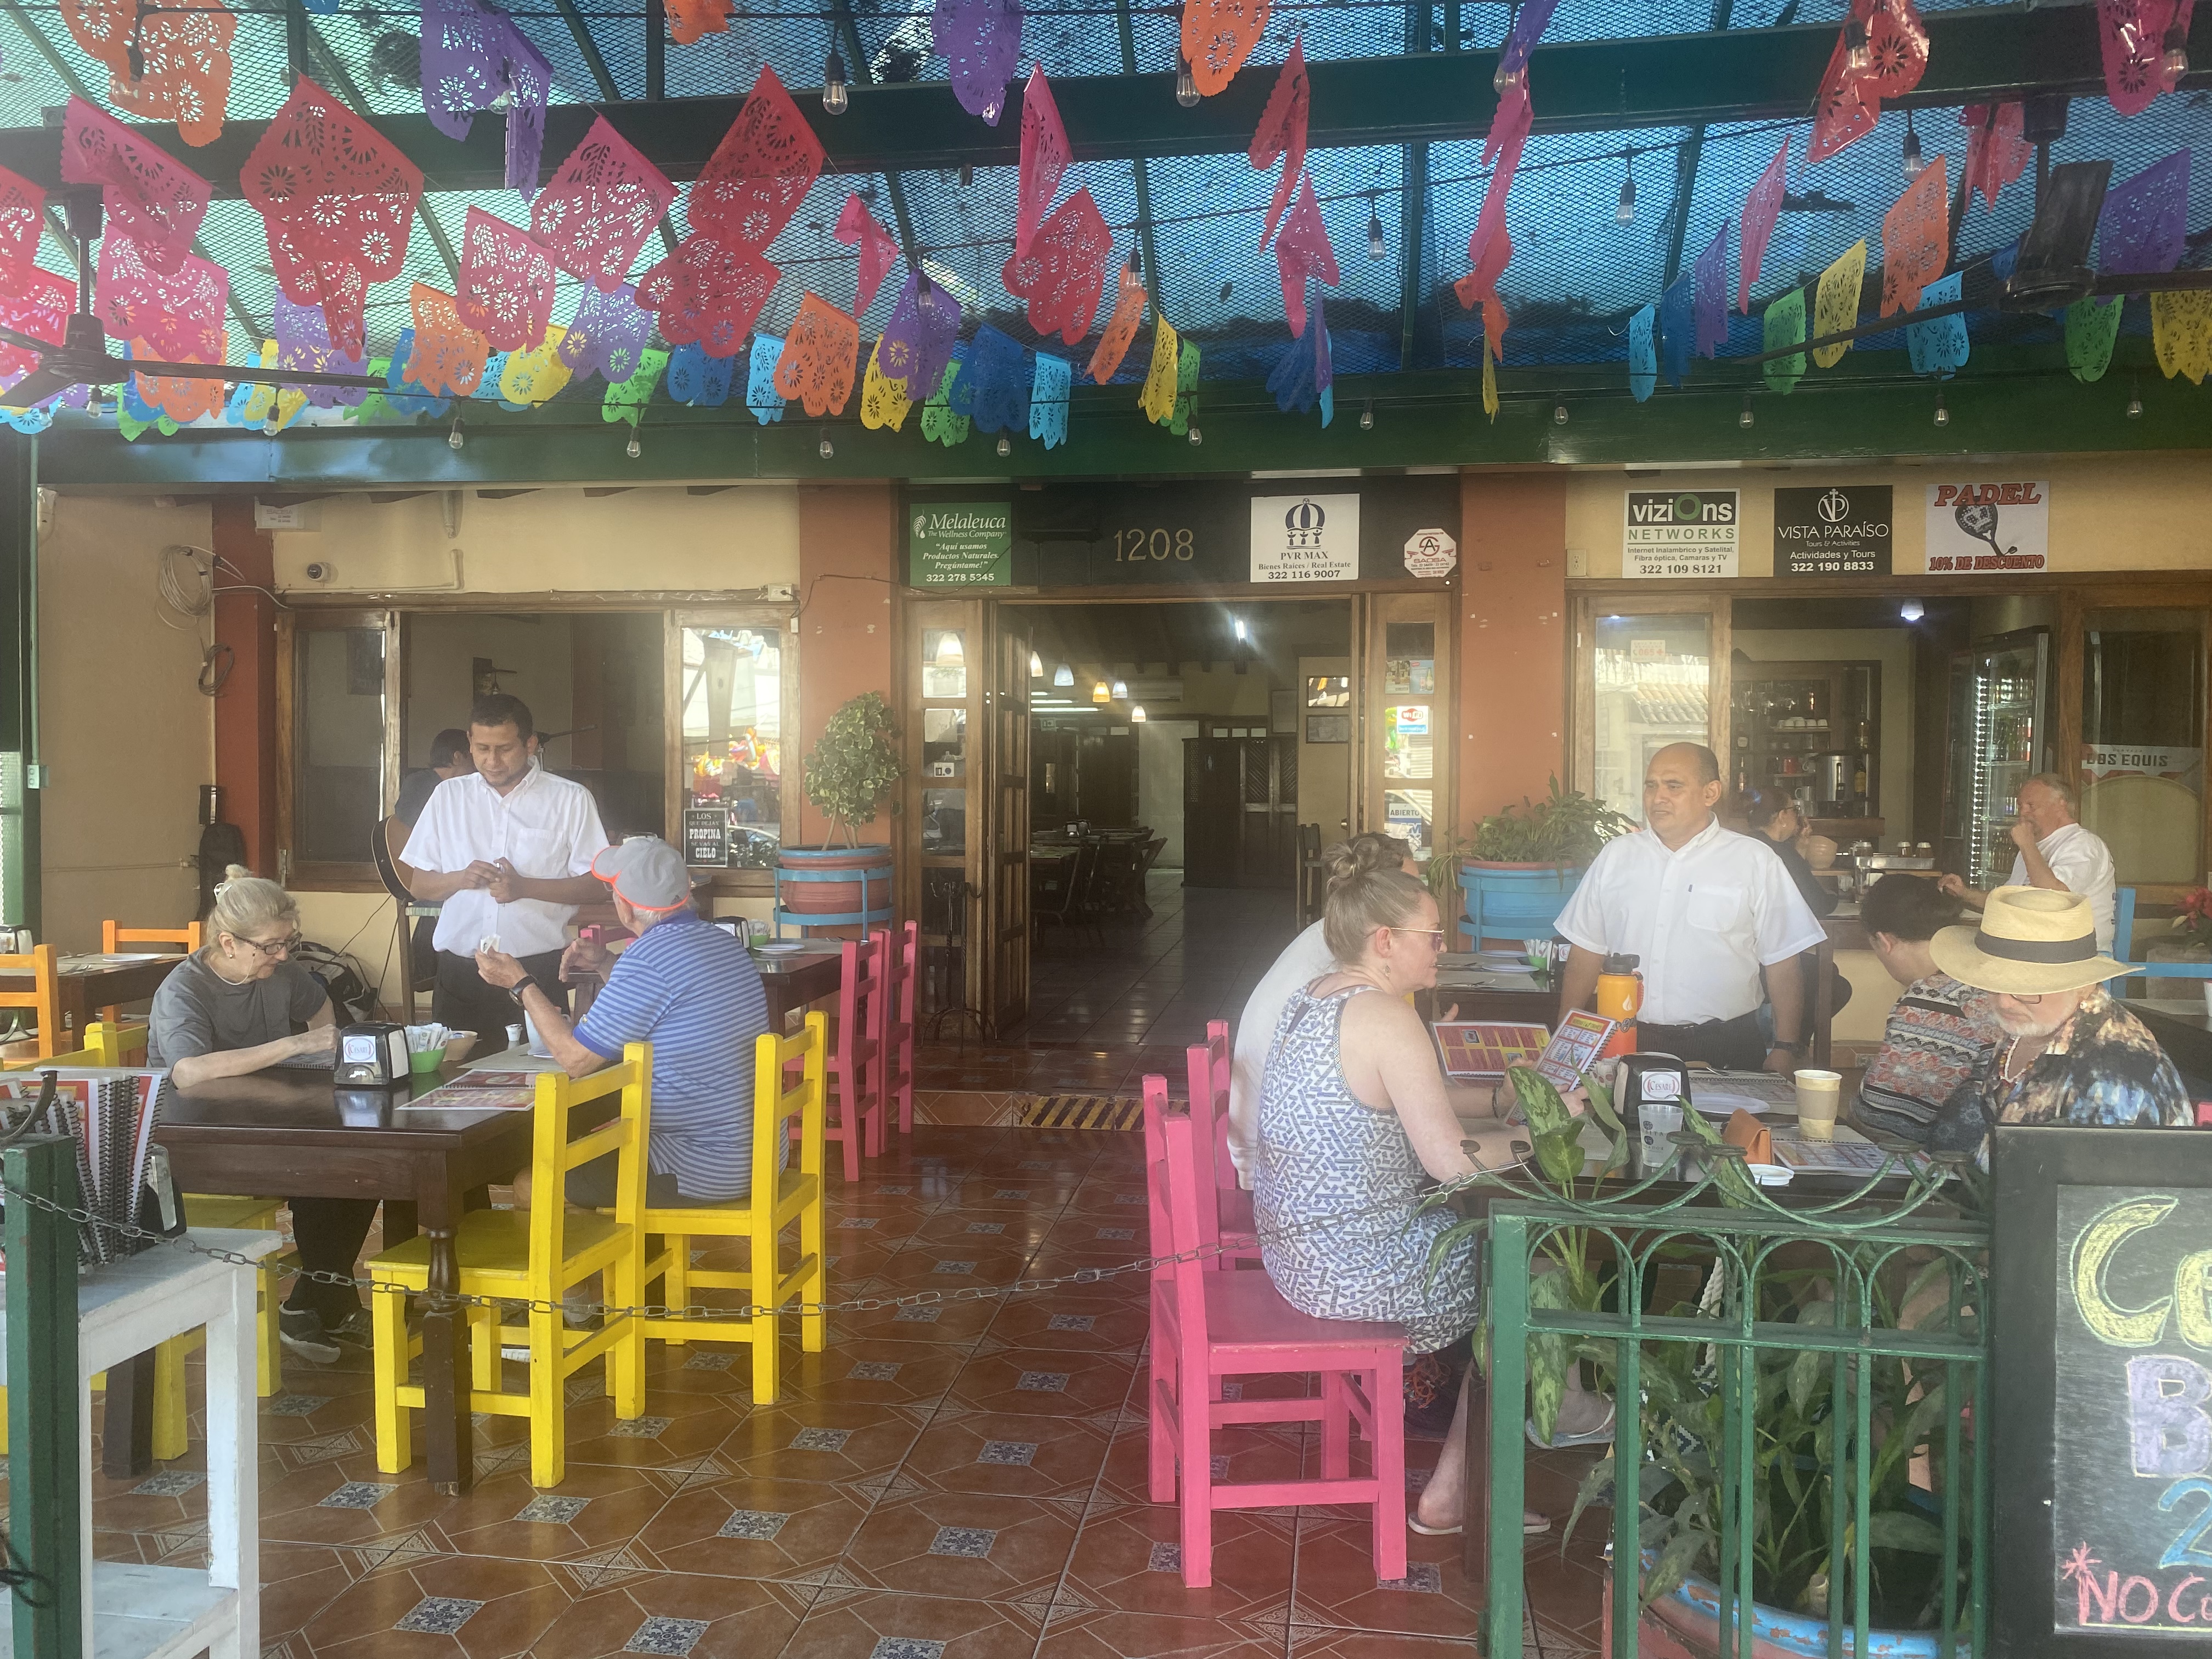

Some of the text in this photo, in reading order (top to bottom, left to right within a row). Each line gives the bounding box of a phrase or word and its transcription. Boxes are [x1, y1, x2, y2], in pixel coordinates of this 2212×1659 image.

[1934, 483, 2041, 506] PADEL
[928, 513, 1006, 529] Melaleuca
[1628, 528, 1734, 540] NETWORKS
[1778, 521, 1888, 539] VISTA PARAÍSO
[1114, 528, 1194, 561] 1208
[1280, 551, 1329, 560] PVR MAX
[1790, 551, 1841, 559] Actividades
[1791, 561, 1874, 572] 322 190 8833
[1929, 554, 2045, 571] 10% DE DESCUENTO
[1640, 565, 1722, 574] 322 109 8121
[2121, 754, 2168, 766] EQUIS
[690, 828, 721, 839] PROPINA
[696, 848, 716, 858] CIELO
[1650, 1081, 1672, 1091] CESARE
